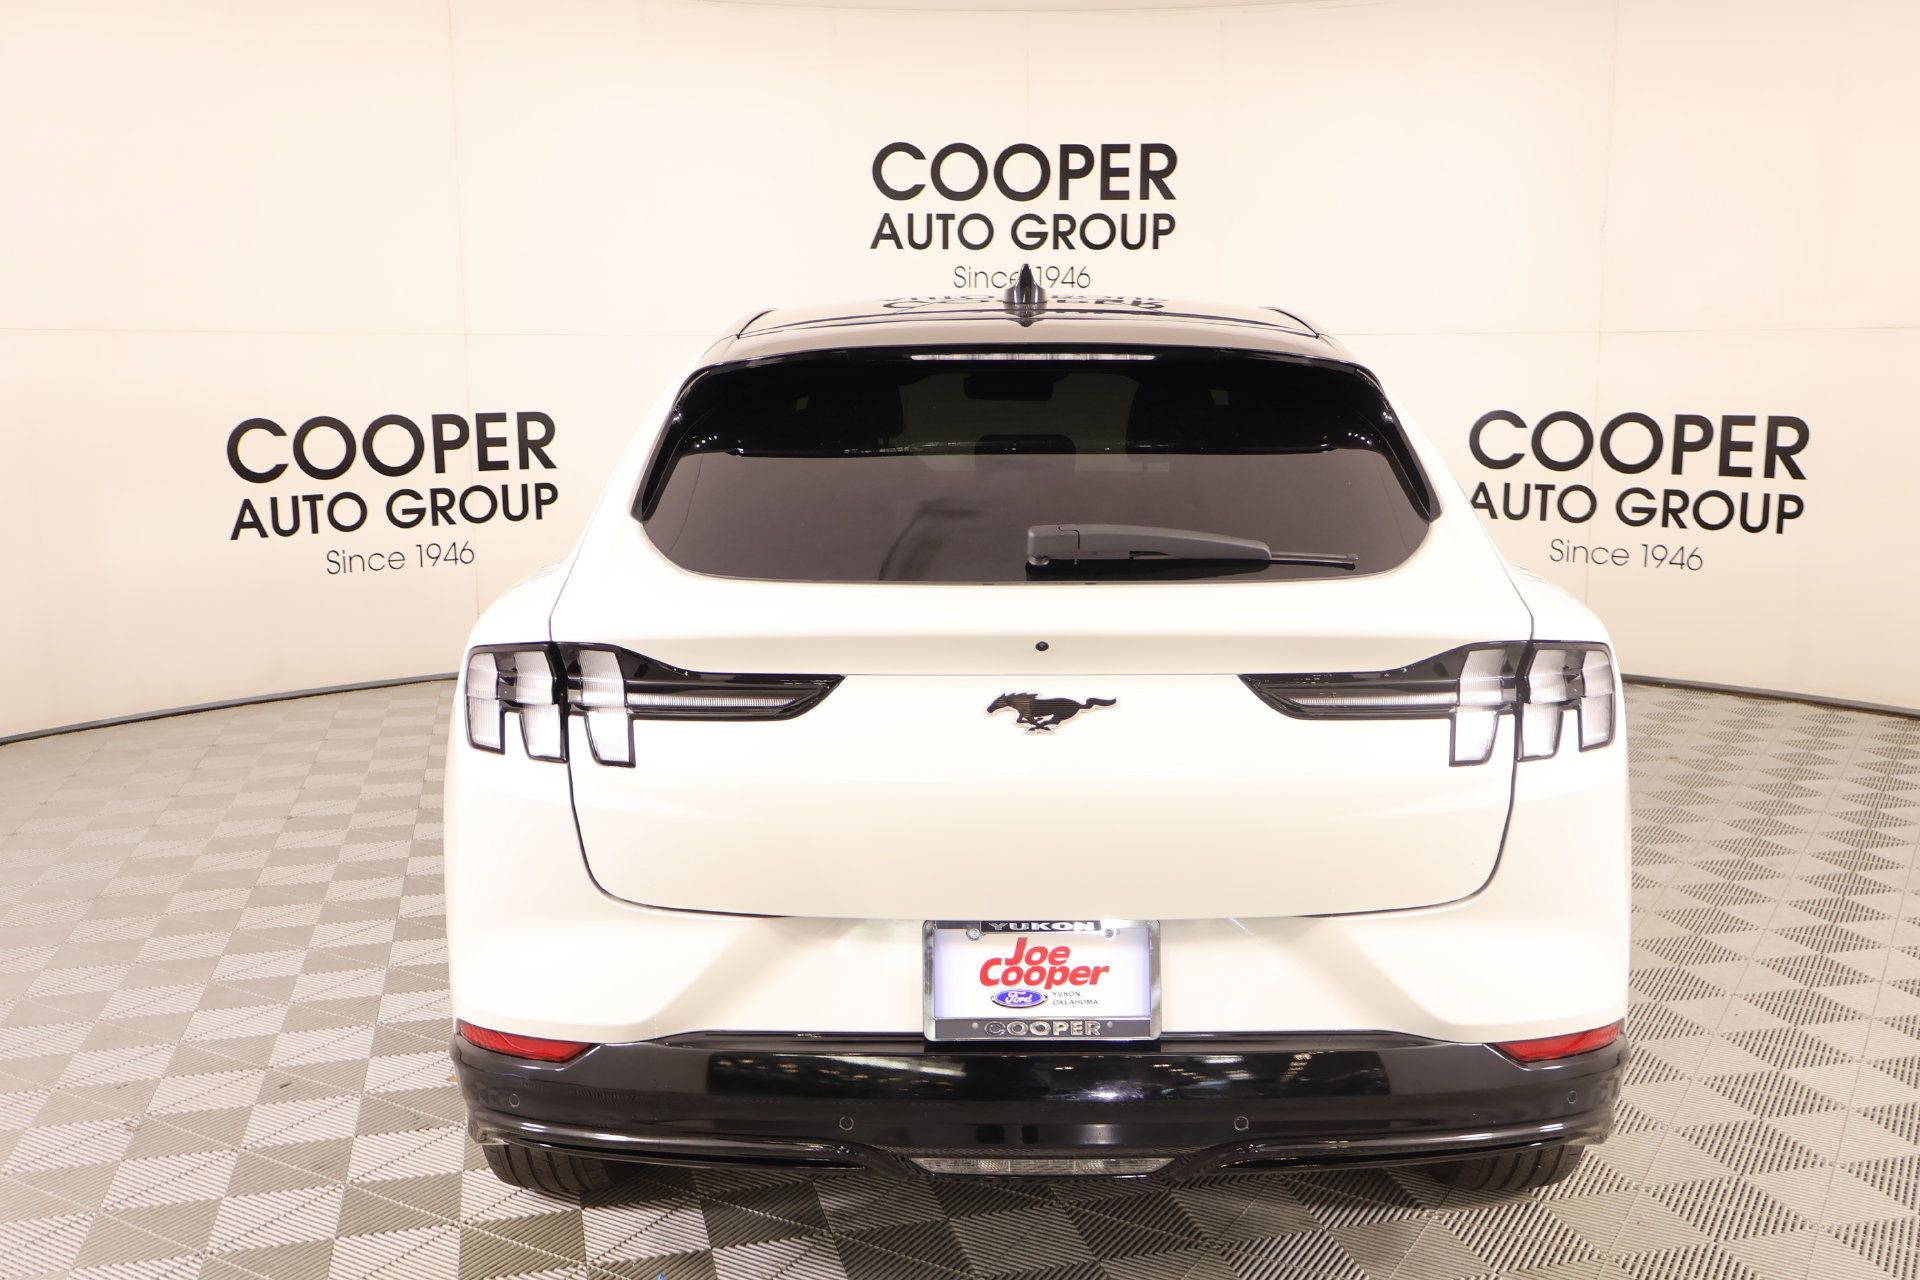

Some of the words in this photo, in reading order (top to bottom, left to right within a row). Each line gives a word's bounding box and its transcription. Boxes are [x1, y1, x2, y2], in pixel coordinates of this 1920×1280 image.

[872, 142, 1178, 201] COOPER
[870, 213, 994, 250] AUTO
[1011, 213, 1176, 250] GROUP
[1036, 266, 1091, 288] 1946
[227, 411, 557, 483] COOPER
[1469, 410, 1810, 480] COOPER
[230, 491, 368, 540] AUTO
[386, 482, 559, 529] GROUP
[1470, 482, 1598, 524] AUTO
[1615, 487, 1805, 534] GROUP
[326, 550, 406, 575] Since
[416, 541, 475, 568] 1946
[1549, 539, 1630, 567] Since
[1641, 543, 1704, 572] 1946
[988, 921, 1096, 931] YUKON
[1004, 937, 1071, 967] Joe
[979, 957, 1110, 990] Cooper
[1004, 990, 1034, 1004] Ford
[984, 1020, 1101, 1036] COOPER
